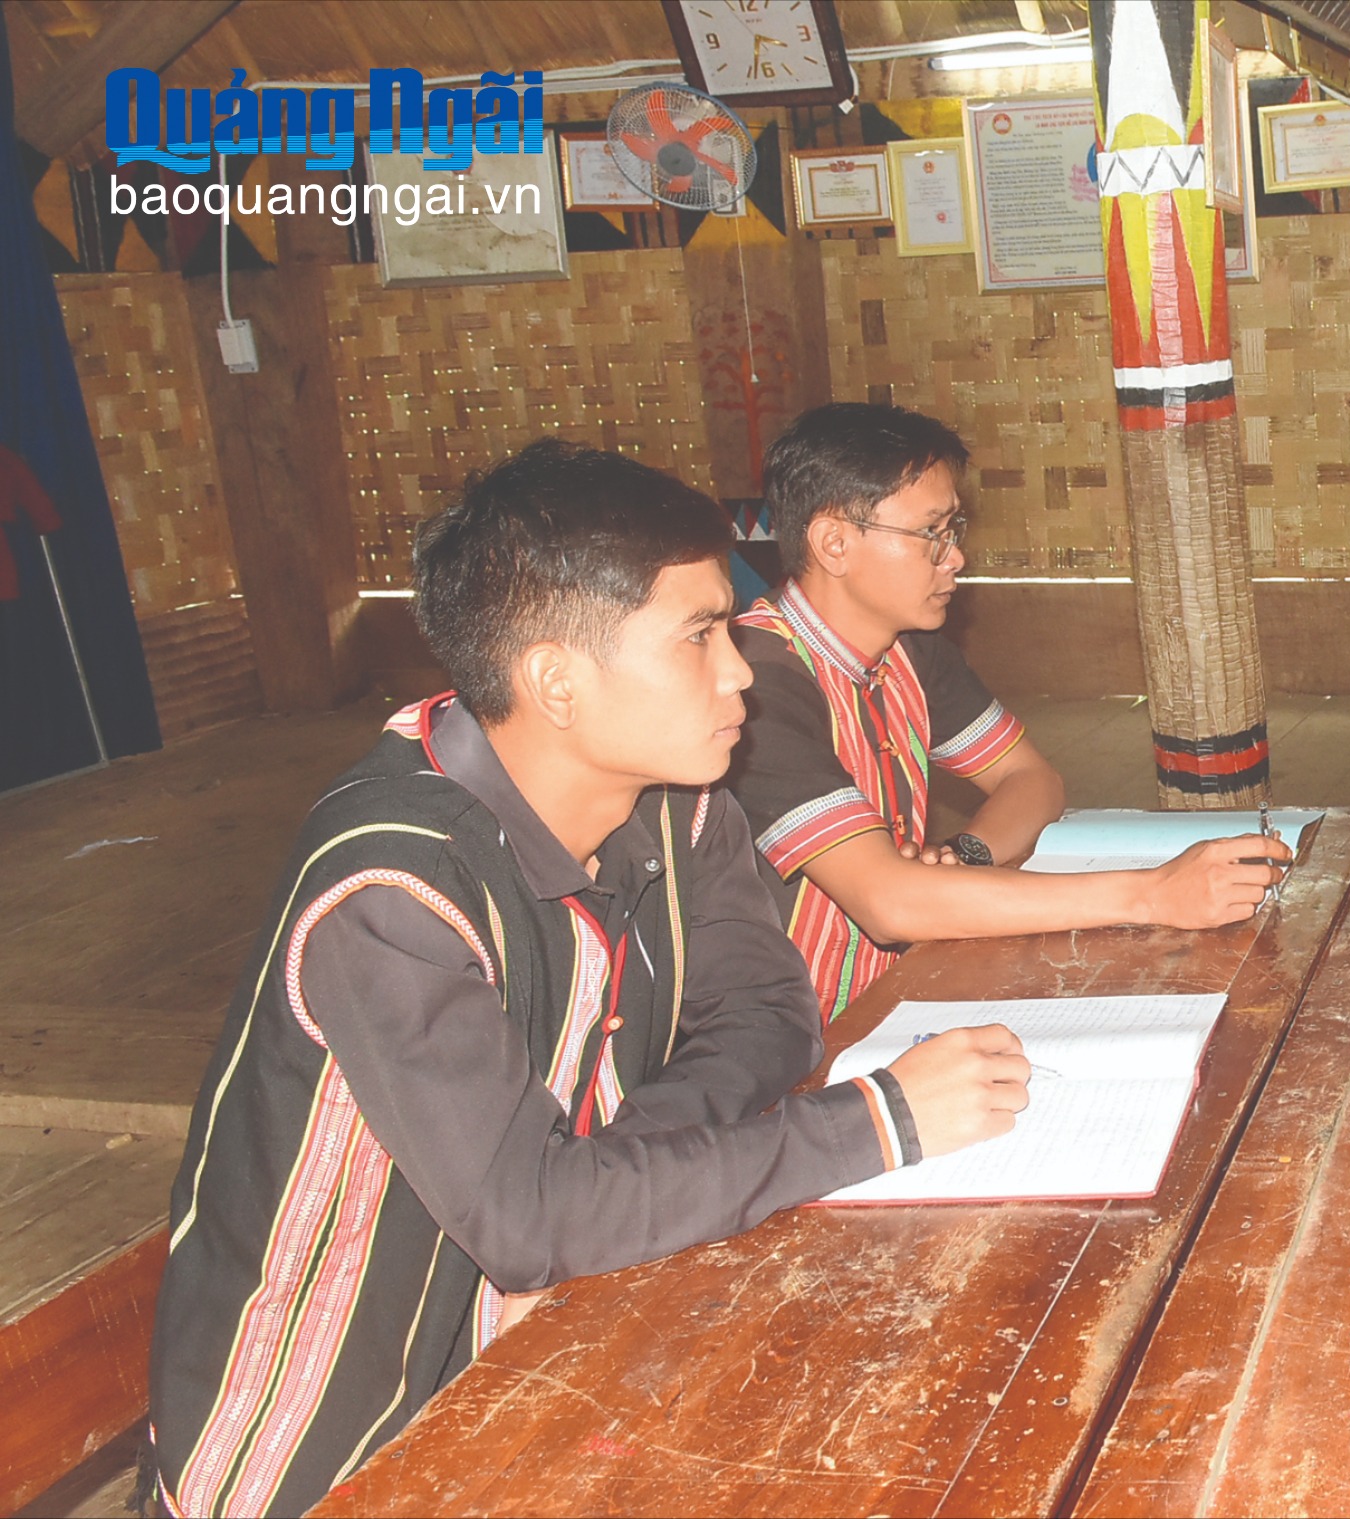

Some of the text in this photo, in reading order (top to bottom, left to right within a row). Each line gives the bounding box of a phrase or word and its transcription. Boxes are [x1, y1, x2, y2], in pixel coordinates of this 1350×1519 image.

[706, 33, 720, 49] 9
[796, 25, 811, 42] 3
[761, 62, 776, 78] 6
